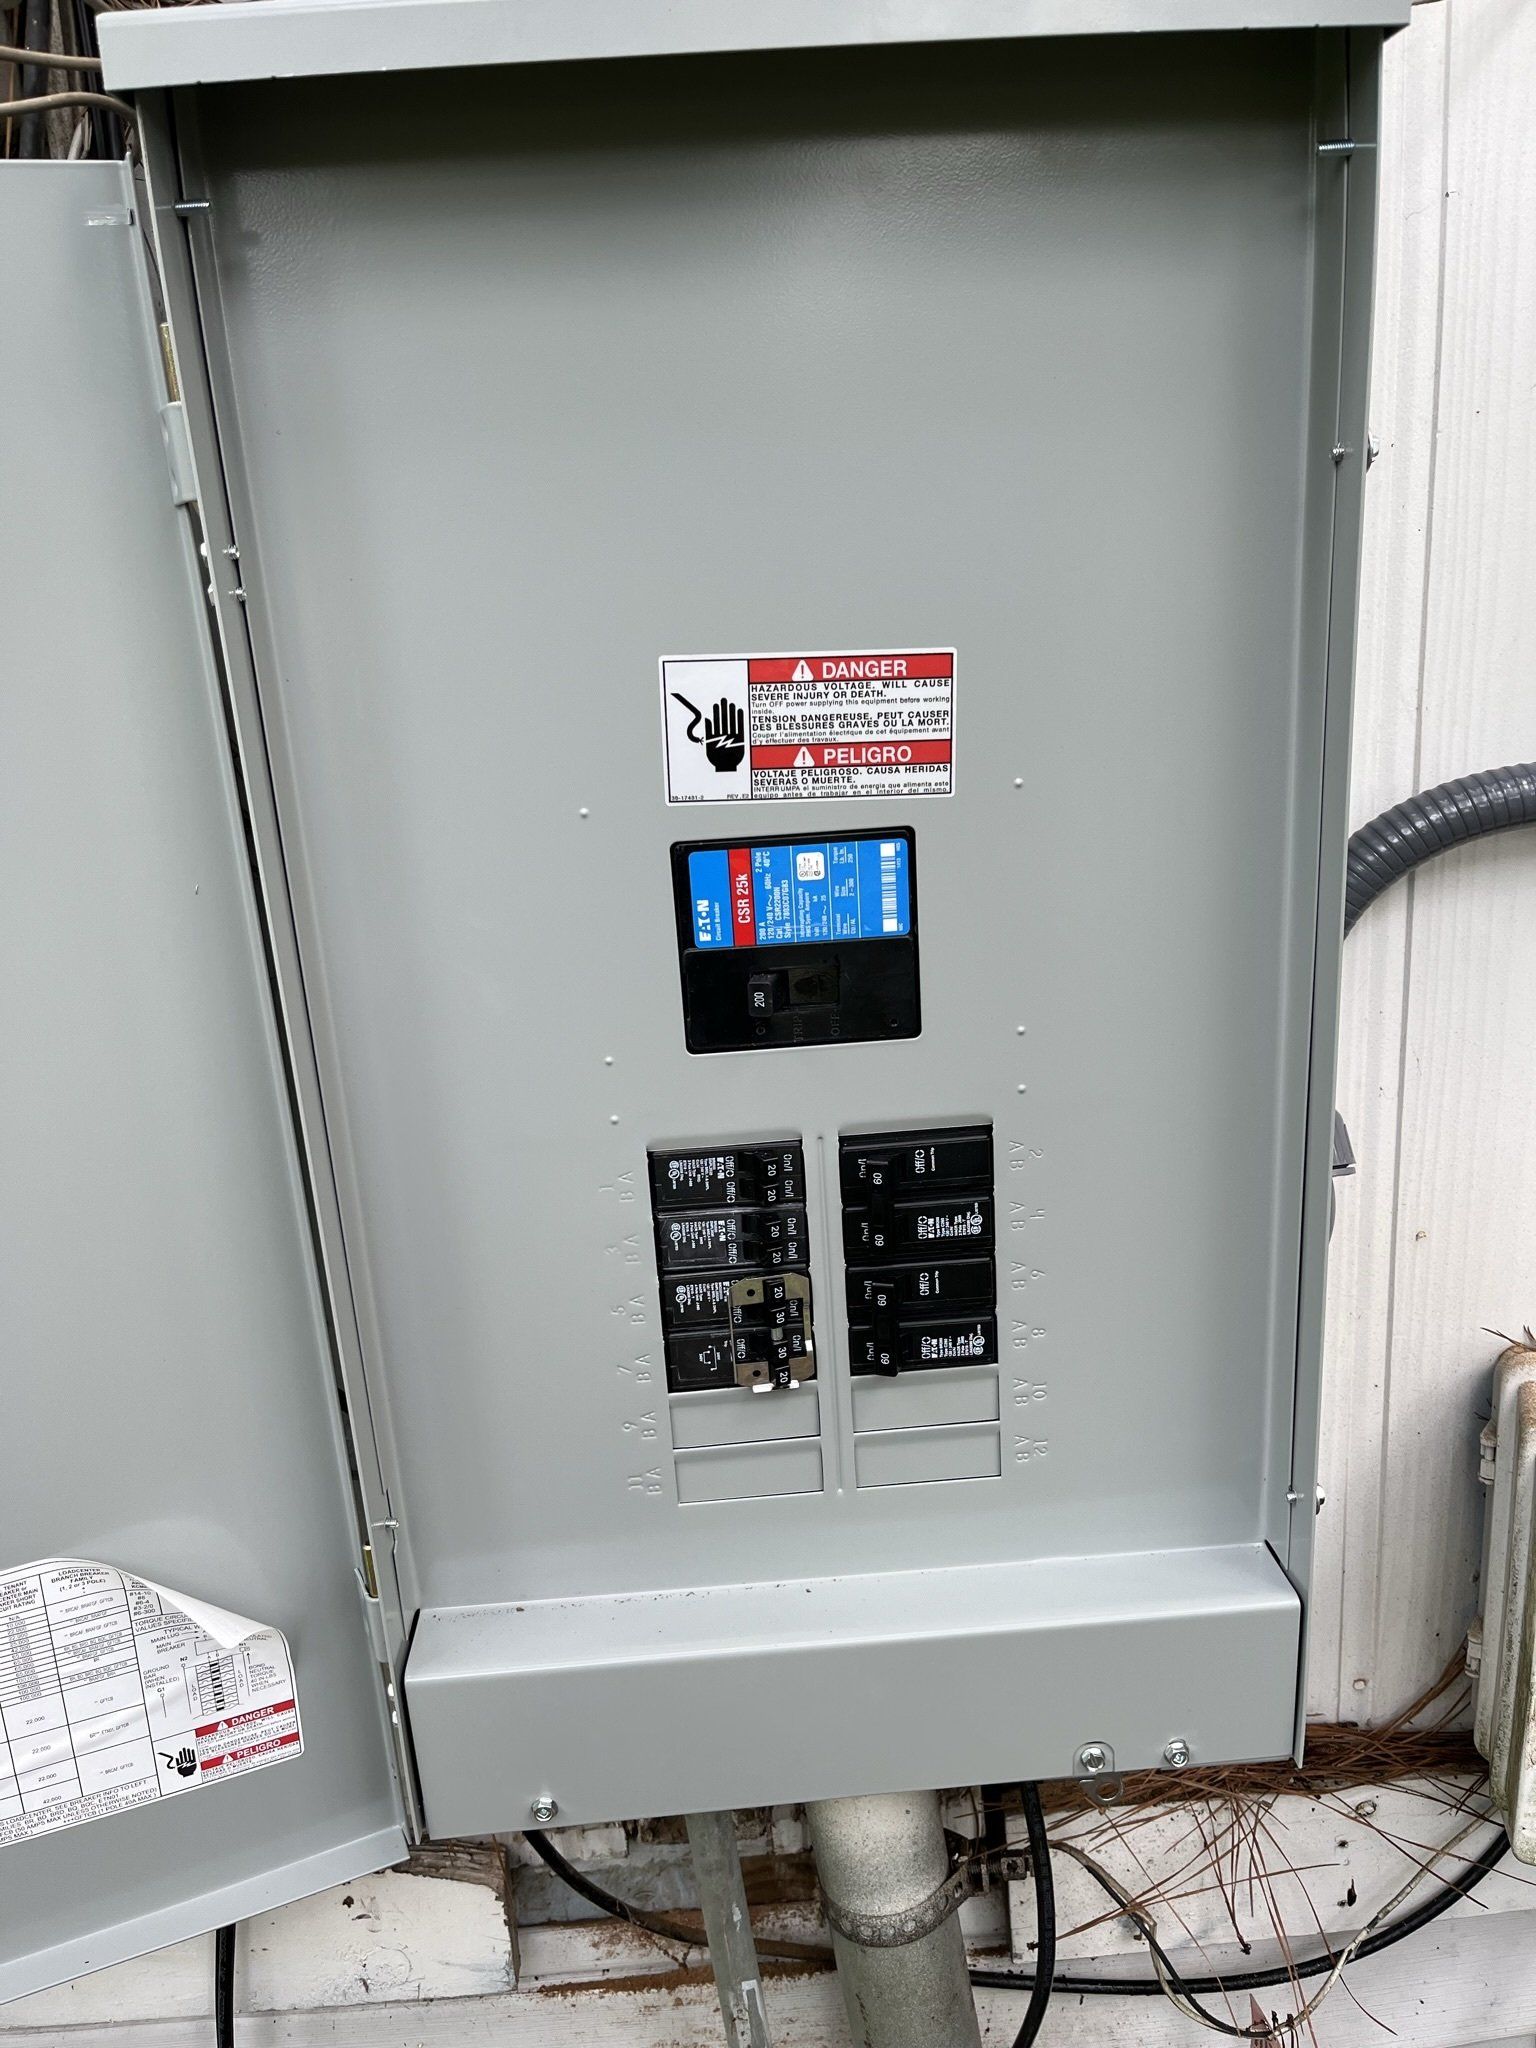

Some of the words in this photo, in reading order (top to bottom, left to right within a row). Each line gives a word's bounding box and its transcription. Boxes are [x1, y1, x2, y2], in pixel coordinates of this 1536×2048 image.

[822, 659, 908, 679] DANGER
[751, 683, 818, 693] HAZARDOUS
[824, 681, 875, 691] VOLTAGE.
[882, 680, 908, 689] WILL
[914, 679, 950, 688] CAUSE
[751, 692, 790, 701] SEVERE
[792, 691, 830, 699] INJURY
[833, 691, 847, 699] OR
[850, 689, 887, 698] DEATH.
[769, 700, 783, 708] OFF
[809, 698, 843, 707] supplying
[861, 697, 898, 705] equipment
[752, 715, 797, 723] TENSION
[801, 712, 873, 722] DANGEREUSE.
[877, 711, 903, 720] PEUT
[908, 710, 949, 719] CAUSER
[753, 723, 773, 731] DES
[776, 721, 835, 730] BLESSURES
[839, 720, 879, 729] GRAVES
[883, 719, 898, 728] OU
[901, 719, 914, 727] LA
[917, 718, 949, 726] MORT.
[752, 731, 777, 739] Couper
[779, 730, 826, 738] l'alimentation
[829, 729, 863, 737] électrique
[889, 727, 930, 735] équipement
[823, 746, 912, 765] PELIGRO
[753, 770, 797, 778] VOLTAJE
[801, 768, 863, 777] PELIGROSO.
[866, 766, 901, 775] CAUSA
[905, 765, 949, 774] HERIDAS
[753, 777, 798, 786] SEVERAS
[801, 777, 808, 785] O
[812, 776, 856, 784] MUERTE.
[753, 785, 801, 793] INTERRUMPA
[812, 783, 847, 791] suministro
[820, 789, 848, 797] trabajar
[754, 852, 762, 867] Pole
[763, 851, 771, 868] 40°C
[735, 873, 749, 895] 25k
[764, 872, 772, 890] 60Hz
[797, 888, 805, 909] Capacity
[713, 902, 721, 923] Breaker
[737, 898, 751, 924] CSR
[696, 899, 712, 942] EATON
[765, 912, 775, 939] 120/240
[759, 928, 767, 940] 200
[783, 922, 792, 939] Style
[753, 991, 766, 1008] 200
[1028, 1148, 1044, 1159] 2
[767, 1164, 777, 1177] 20
[872, 1172, 883, 1185] 60
[767, 1189, 777, 1202] 20
[1029, 1208, 1045, 1220] 4
[770, 1225, 780, 1238] 20
[874, 1234, 884, 1247] 60
[772, 1251, 782, 1264] 20
[1030, 1269, 1046, 1280] 6
[774, 1286, 784, 1299] 20
[877, 1294, 887, 1306] 60
[610, 1306, 627, 1316] 5
[775, 1312, 785, 1324] 30
[1031, 1327, 1046, 1338] 8
[778, 1346, 788, 1359] 30
[880, 1353, 890, 1365] 60
[779, 1371, 789, 1383] 20
[1031, 1381, 1047, 1401] 10
[621, 1420, 639, 1432] 9
[1032, 1438, 1048, 1457] 12
[627, 1475, 644, 1491] 11
[3, 1580, 27, 1590] TENANT
[51, 1573, 79, 1584] BRANCH
[70, 1576, 93, 1584] FAMILY
[16, 1594, 36, 1603] SHORT
[23, 1588, 39, 1596] MAIN
[13, 1599, 36, 1609] RATING
[134, 1617, 163, 1627] TORQUE
[135, 1622, 162, 1632] VALUES
[163, 1625, 192, 1634] TYPICAL
[150, 1636, 166, 1644] MAIN
[157, 1642, 186, 1654] BREAKER
[143, 1664, 170, 1675] GROUND
[231, 1706, 275, 1726] DANGER
[236, 1739, 281, 1759] PELIGRO
[69, 1793, 102, 1807] BREAKER
[102, 1788, 119, 1797] INFO
